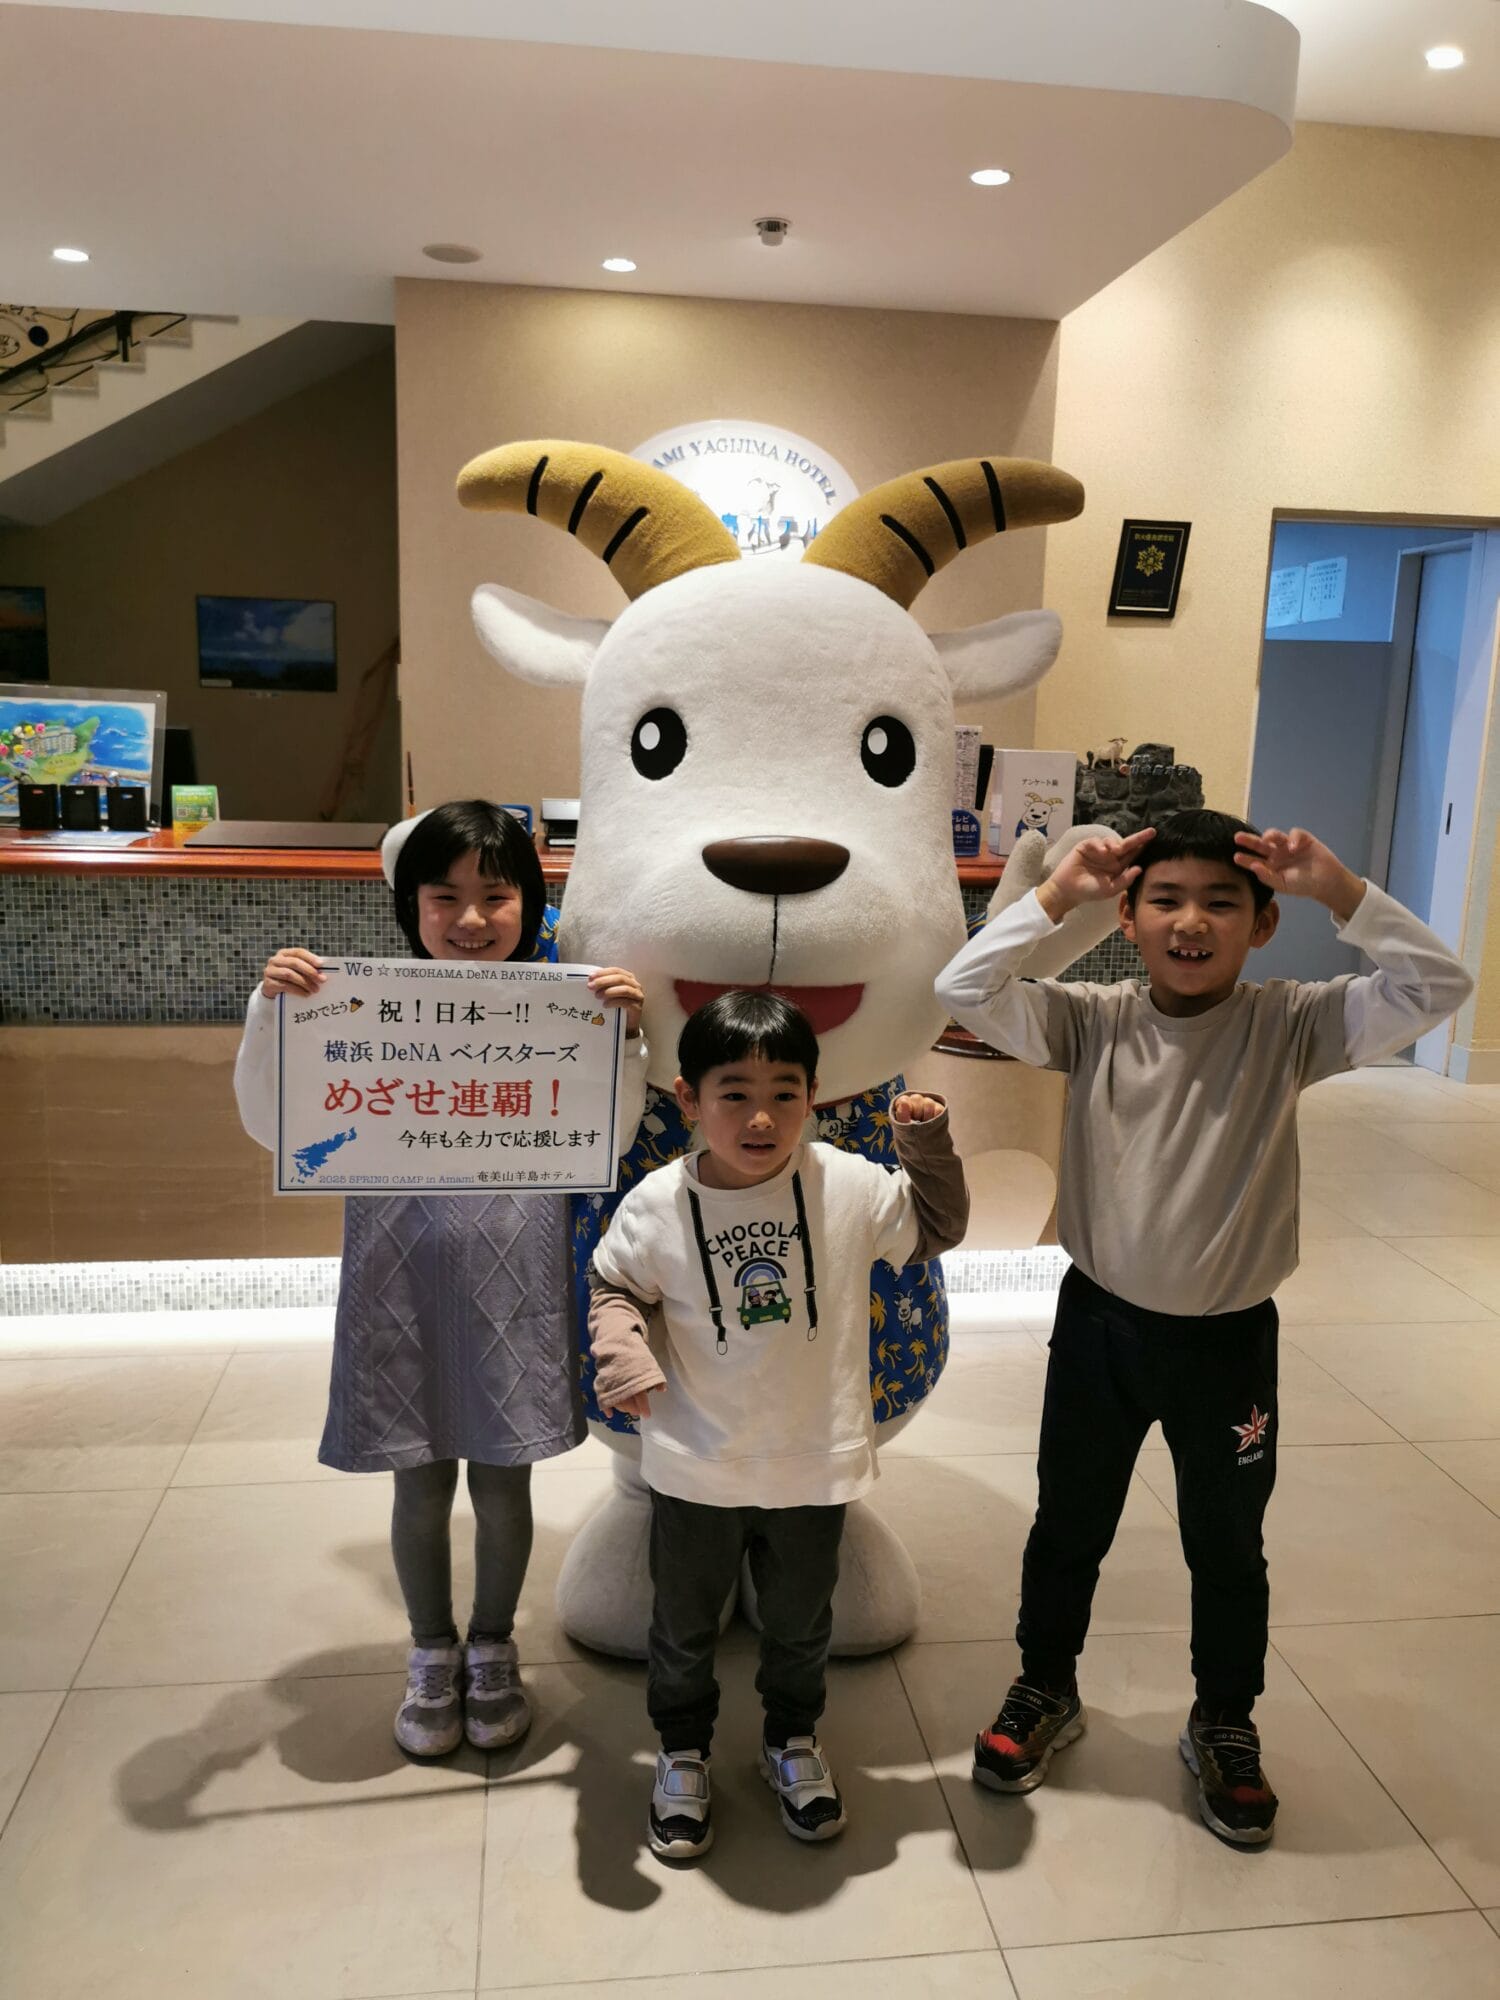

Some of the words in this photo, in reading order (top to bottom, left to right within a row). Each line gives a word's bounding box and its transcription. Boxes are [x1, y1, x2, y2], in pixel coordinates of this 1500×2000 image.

[688, 438, 779, 461] YAGIJIMA
[784, 449, 837, 506] HOTEL
[344, 962, 373, 977] We
[394, 967, 464, 979] YOKOHAMA
[466, 970, 498, 980] DeNA
[500, 971, 563, 982] BAYSTARS
[293, 1001, 349, 1024] おめでとう
[546, 1002, 593, 1021] やったぜ
[324, 1040, 373, 1063] 横浜
[381, 1042, 442, 1062] DeNA
[449, 1043, 580, 1064] ベイスターズ
[398, 1129, 602, 1149] 今年も全力で応援します
[319, 1175, 347, 1185] 2025
[349, 1174, 390, 1185] SPRING
[392, 1174, 424, 1185] CAMP
[425, 1174, 436, 1184] in
[438, 1174, 475, 1185] Amami
[477, 1170, 576, 1183] 奄美山羊島ホテル
[705, 1221, 802, 1255] CHOCOLA
[721, 1240, 790, 1268] PEACE
[1237, 1449, 1264, 1466] ENGLAND
